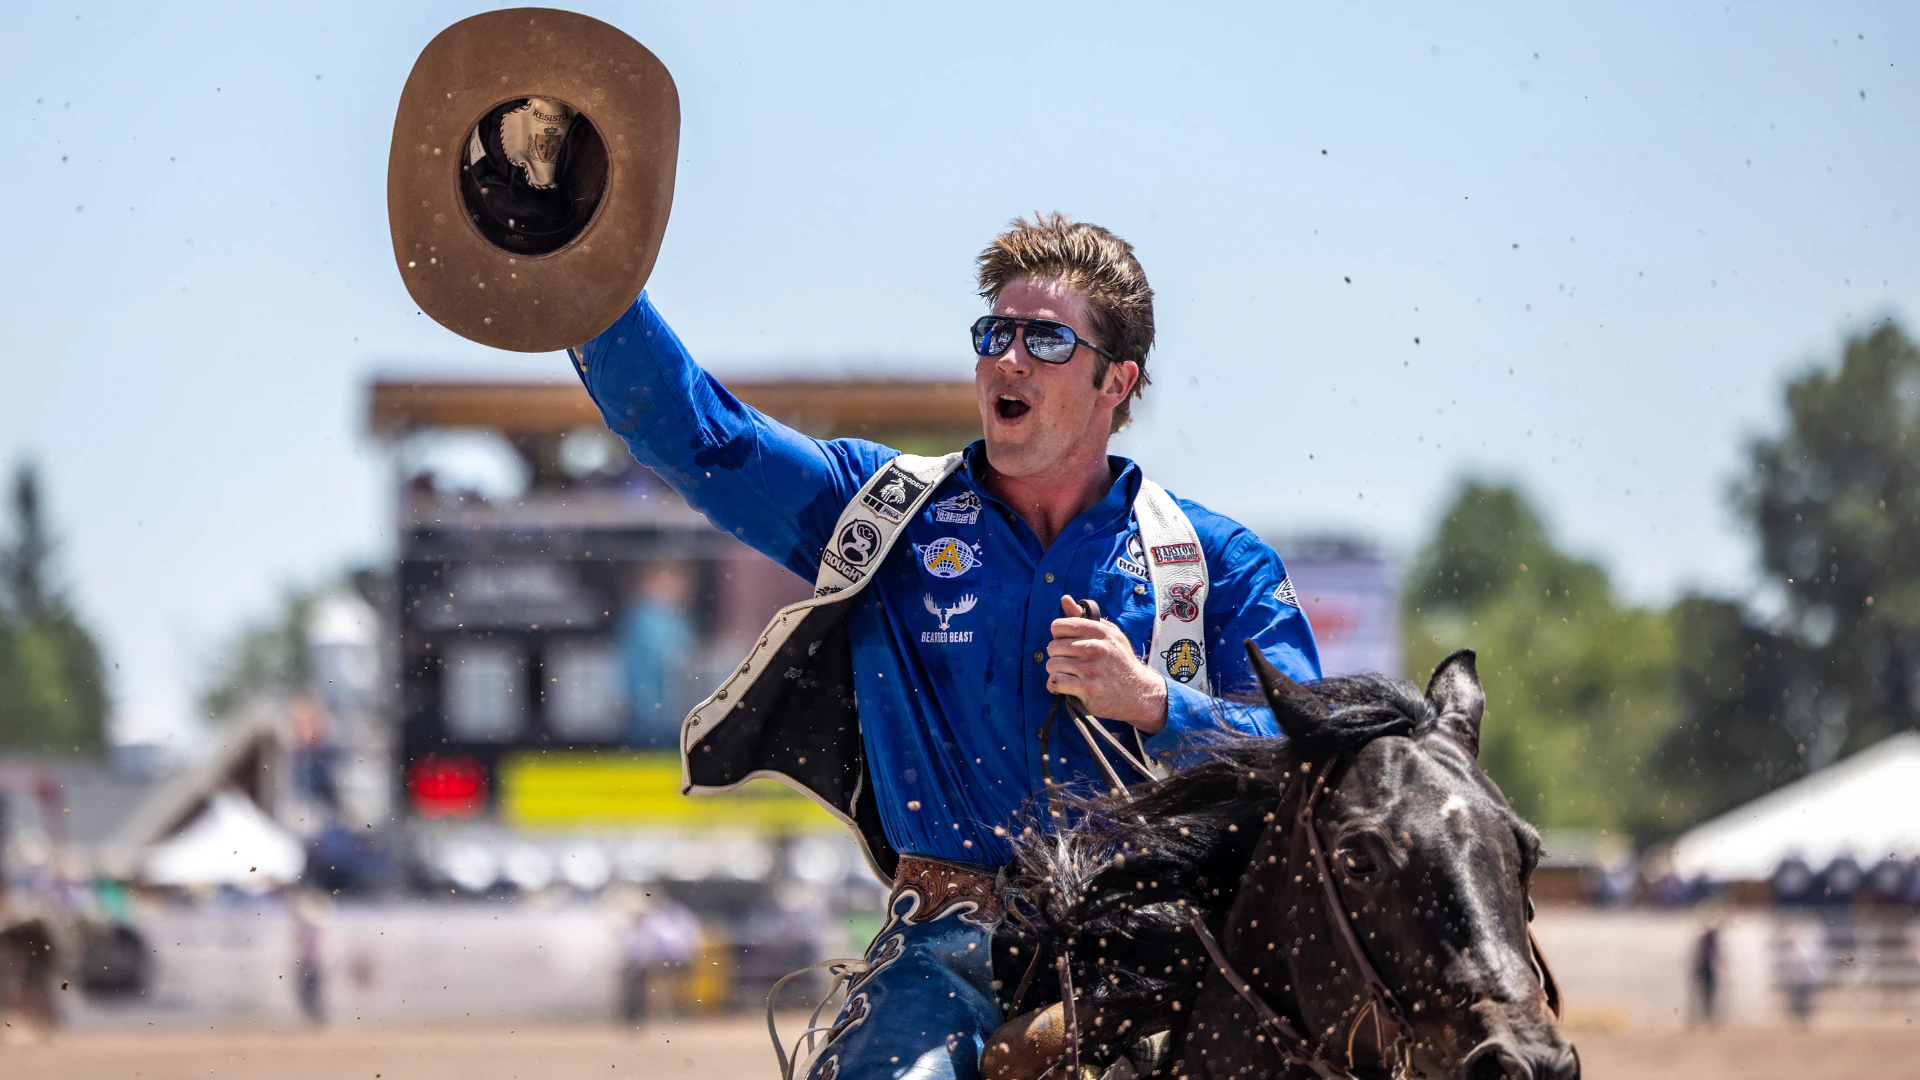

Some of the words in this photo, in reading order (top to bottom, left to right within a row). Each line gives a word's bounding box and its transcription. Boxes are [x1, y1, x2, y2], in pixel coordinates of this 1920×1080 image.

[889, 467, 926, 490] PRORODEO
[928, 540, 963, 572] A
[921, 631, 948, 643] BEARDED
[949, 631, 974, 643] BEAST
[1170, 641, 1195, 675] A
